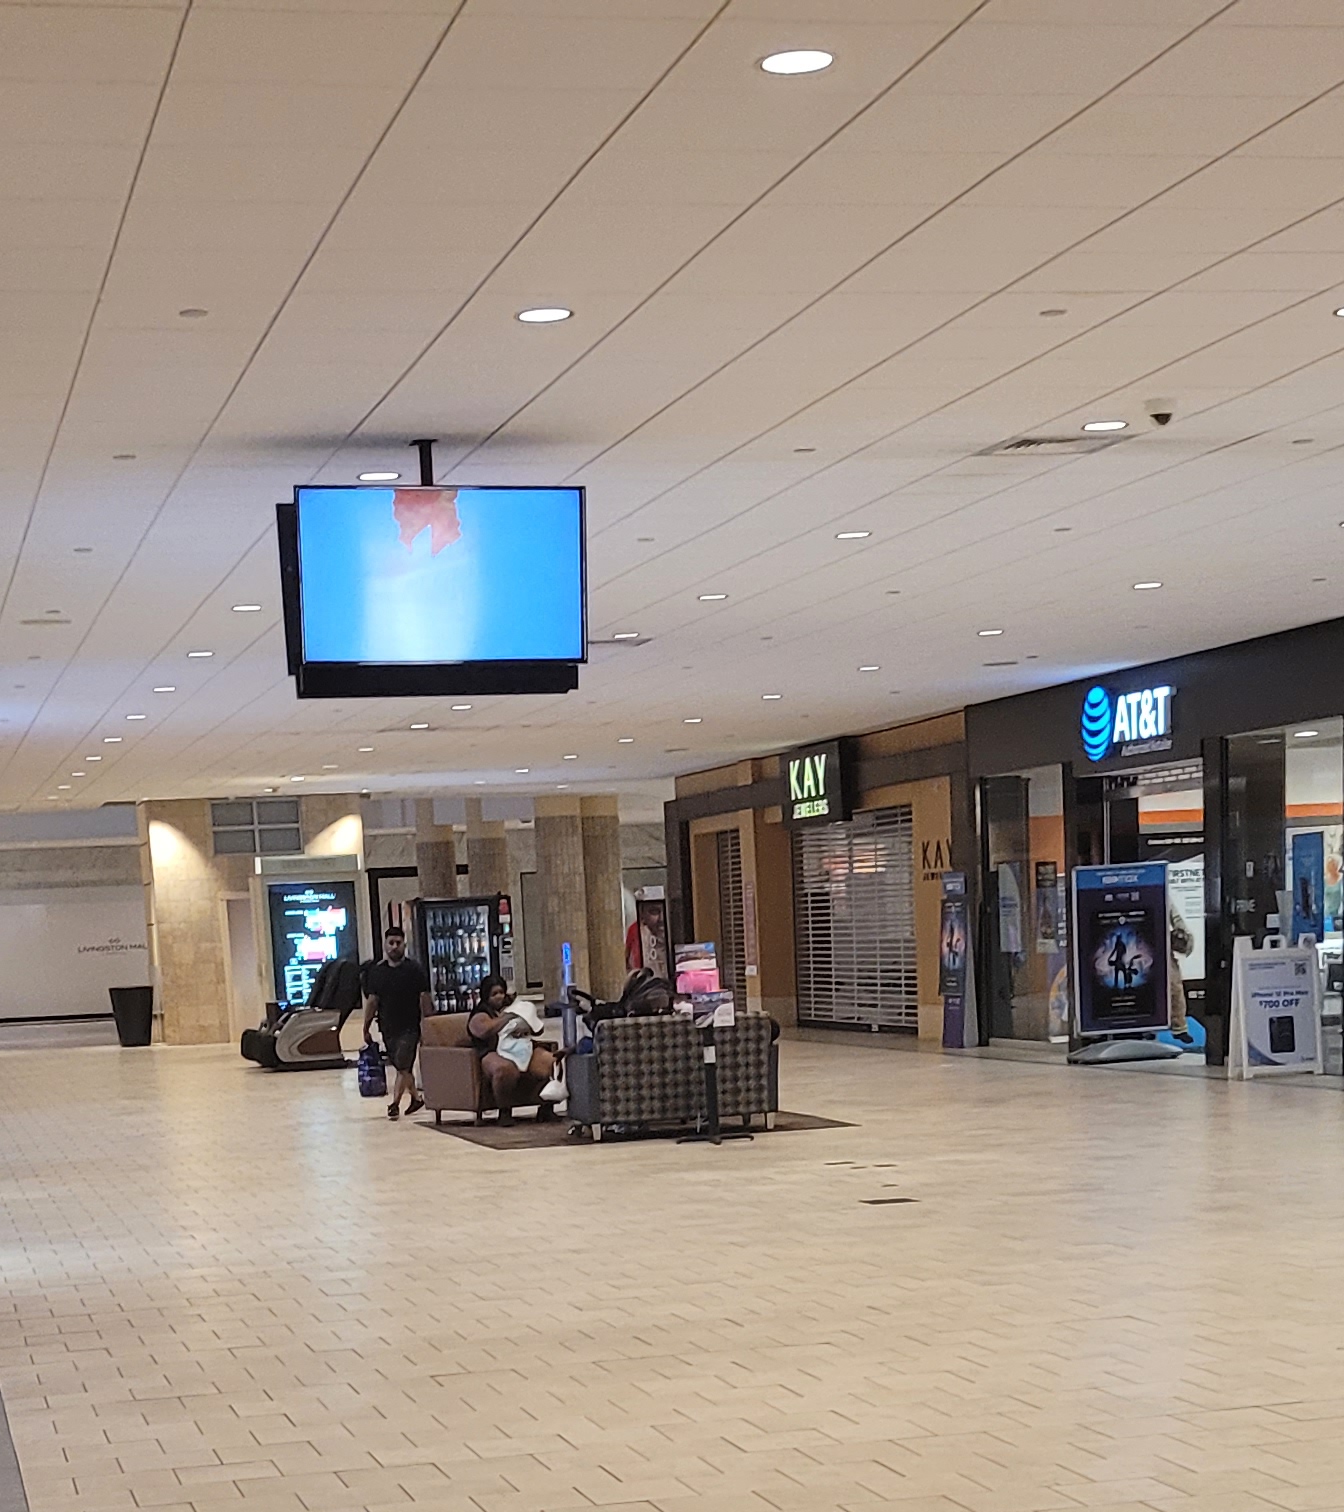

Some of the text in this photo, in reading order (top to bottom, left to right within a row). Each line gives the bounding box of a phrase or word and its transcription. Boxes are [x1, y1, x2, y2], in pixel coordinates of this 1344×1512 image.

[1112, 685, 1175, 744] AT&T
[789, 754, 827, 801] KAY
[77, 943, 148, 954] LIVINGSTON MAL
[1259, 998, 1301, 1009] $700 OFF
